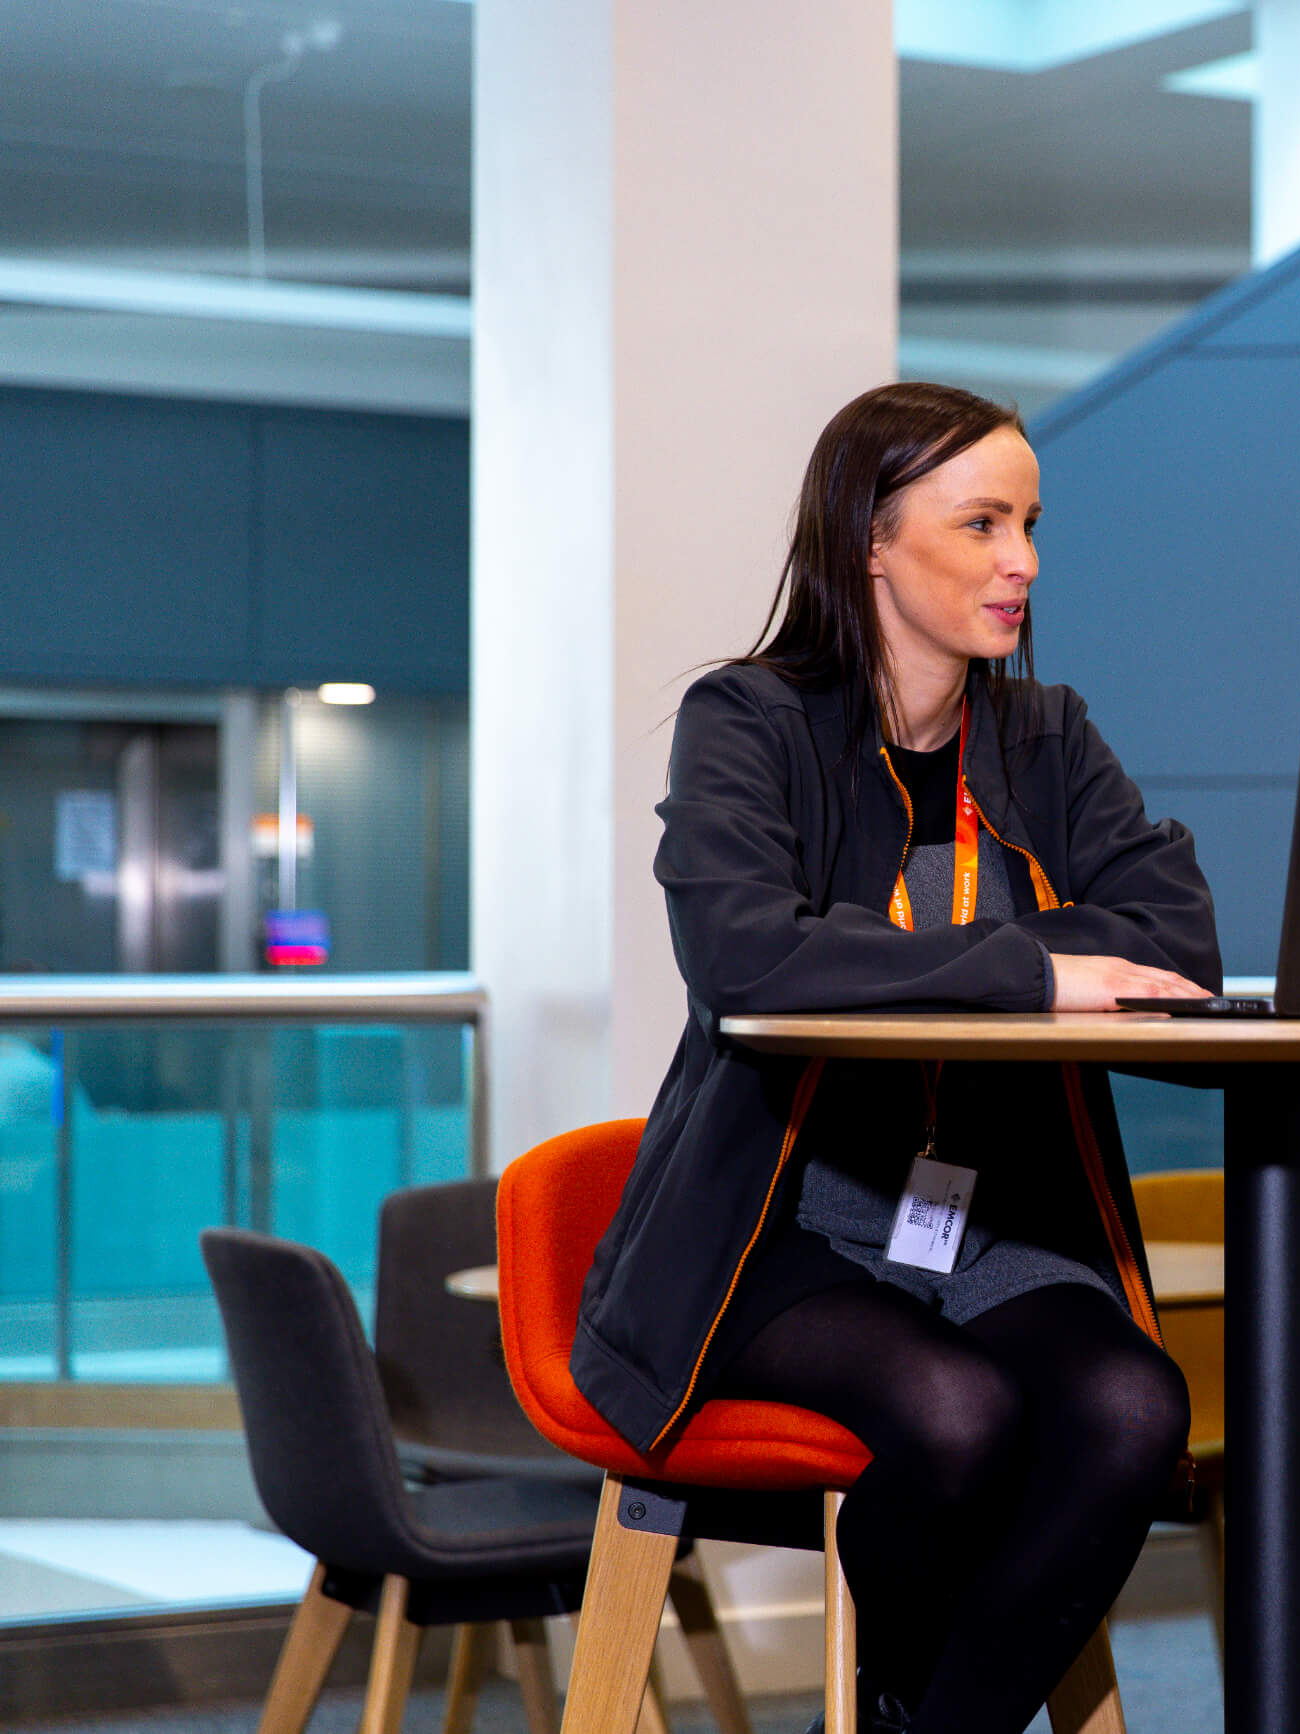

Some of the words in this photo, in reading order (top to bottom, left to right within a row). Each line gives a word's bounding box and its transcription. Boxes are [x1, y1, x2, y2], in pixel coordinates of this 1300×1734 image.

[963, 872, 971, 895] work
[895, 898, 903, 909] at
[963, 896, 969, 907] at
[896, 911, 907, 930] orld
[941, 1204, 957, 1239] EMCOR
